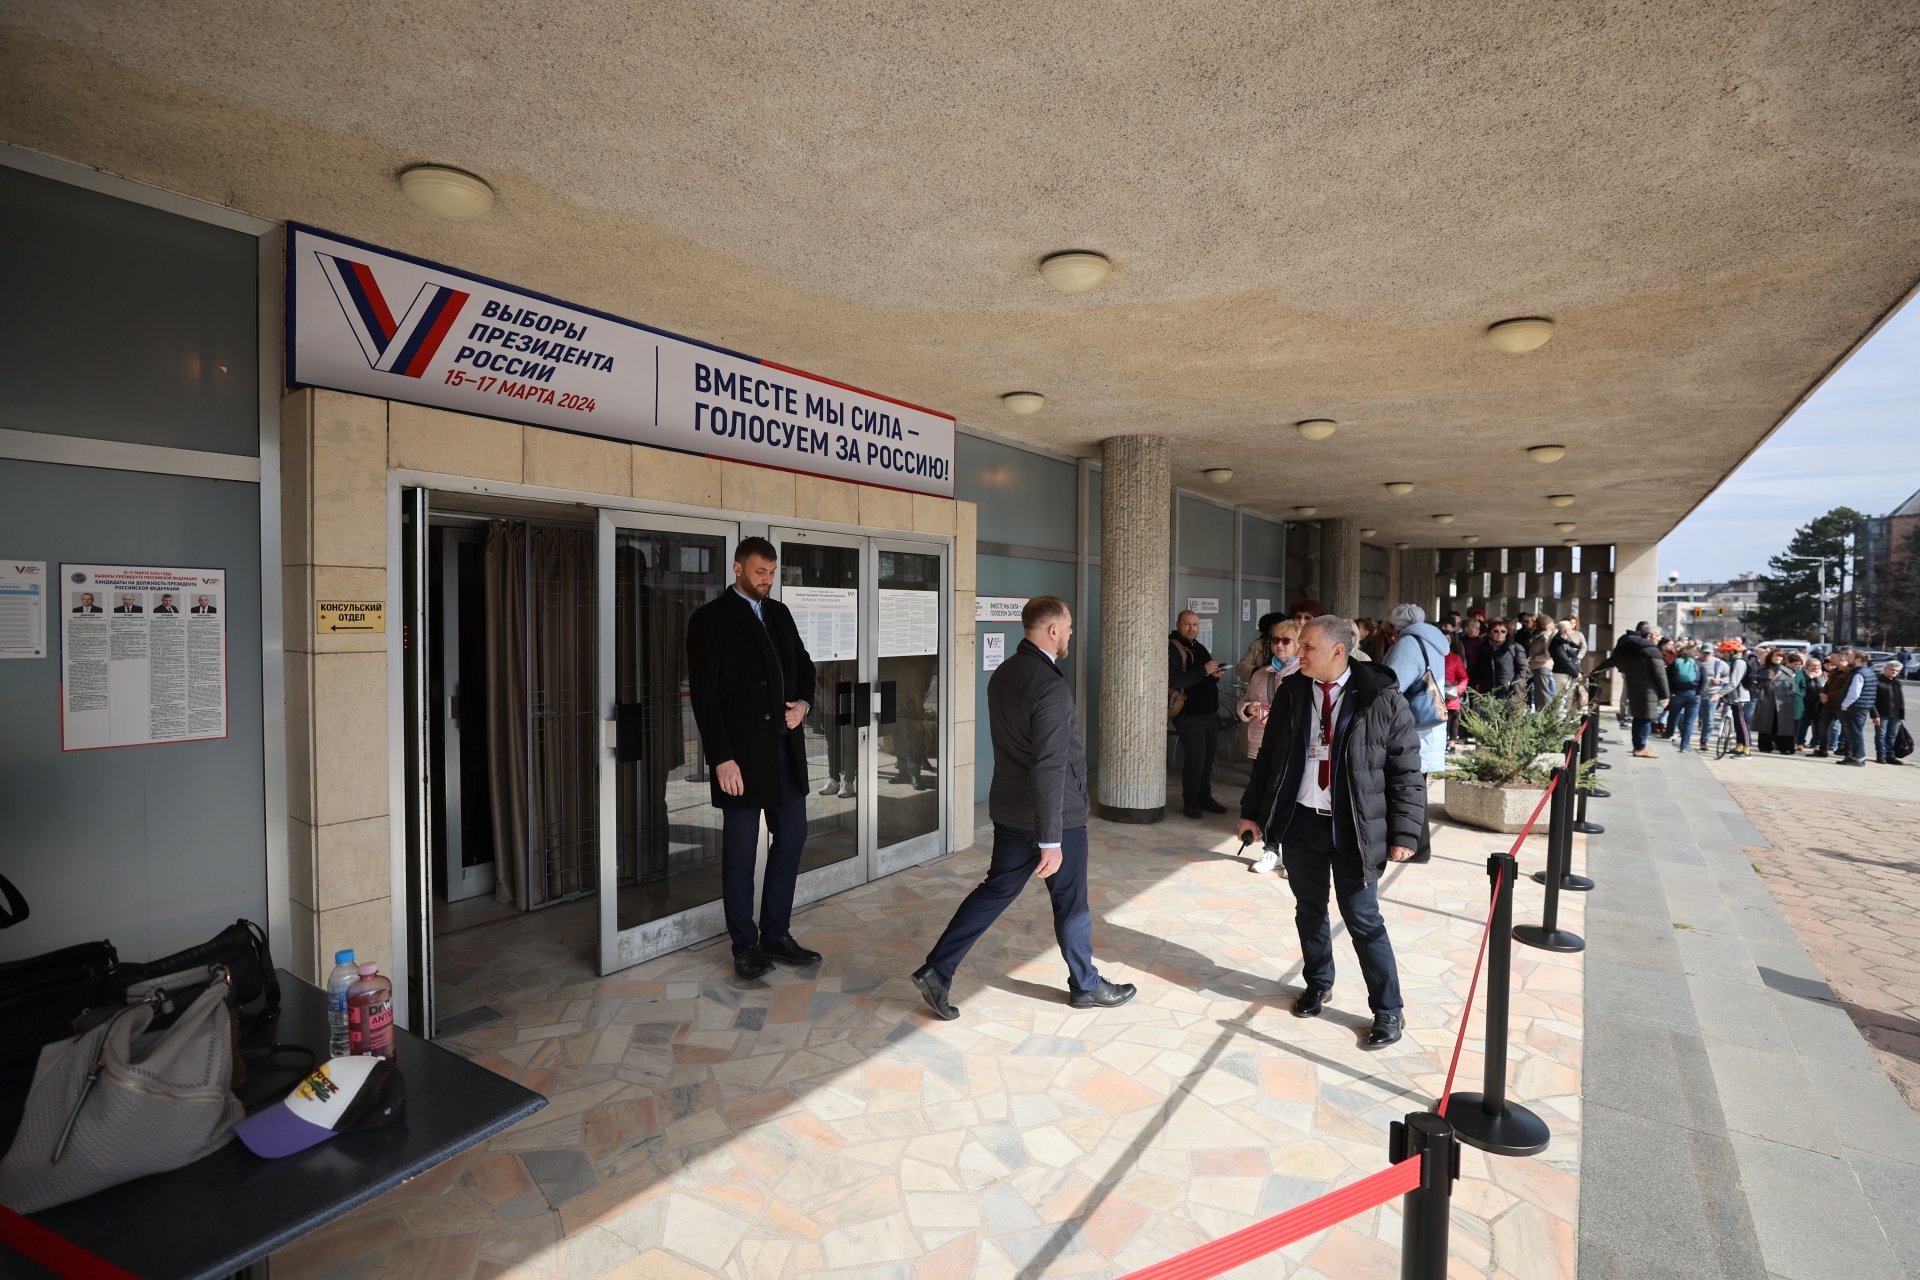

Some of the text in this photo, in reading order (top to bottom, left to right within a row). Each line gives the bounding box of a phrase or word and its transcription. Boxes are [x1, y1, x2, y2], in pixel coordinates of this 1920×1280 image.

[481, 300, 588, 341] ВЫБОРЫ
[454, 345, 556, 383] РОССИИ
[468, 322, 615, 373] ПРЕЗИДЕНТА
[497, 380, 555, 405] МАРТА
[557, 392, 596, 412] 2024
[695, 362, 798, 415] ВМЕСТЕ
[806, 393, 844, 426] МЫ
[851, 406, 903, 441] СИЛА
[695, 402, 949, 481] ГОЛОСУЕМ ЗА РОССИЮ!
[320, 603, 382, 612] КОНСУЛЬСКИЙ
[338, 613, 366, 622] ОТДЕЛ
